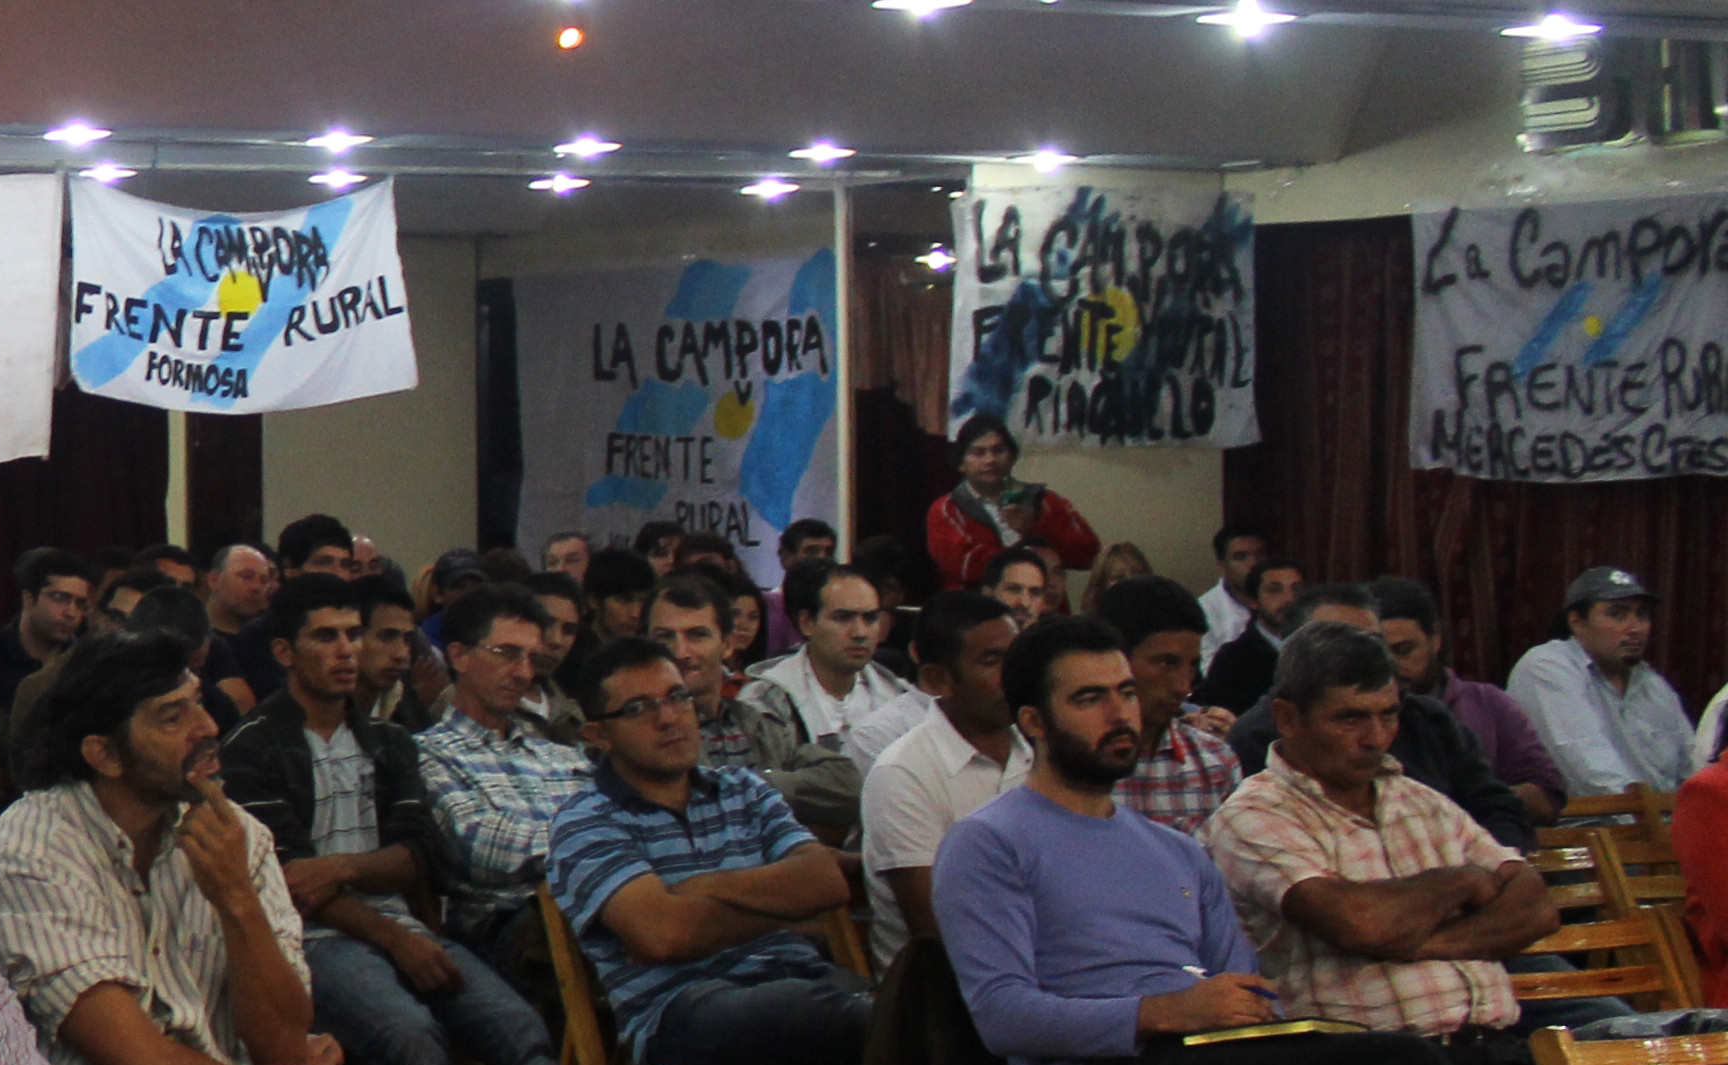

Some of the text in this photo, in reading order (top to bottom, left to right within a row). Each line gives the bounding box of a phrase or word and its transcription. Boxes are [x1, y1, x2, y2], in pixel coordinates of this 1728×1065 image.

[158, 217, 330, 293] LA CAMPORA
[973, 199, 1021, 283] LA
[75, 275, 404, 352] FRENTE RURAL
[146, 350, 248, 399] FORMOSA
[594, 315, 829, 389] LA CAMPORA
[1455, 344, 1647, 421] FRENTE
[606, 431, 714, 484] FRENTE
